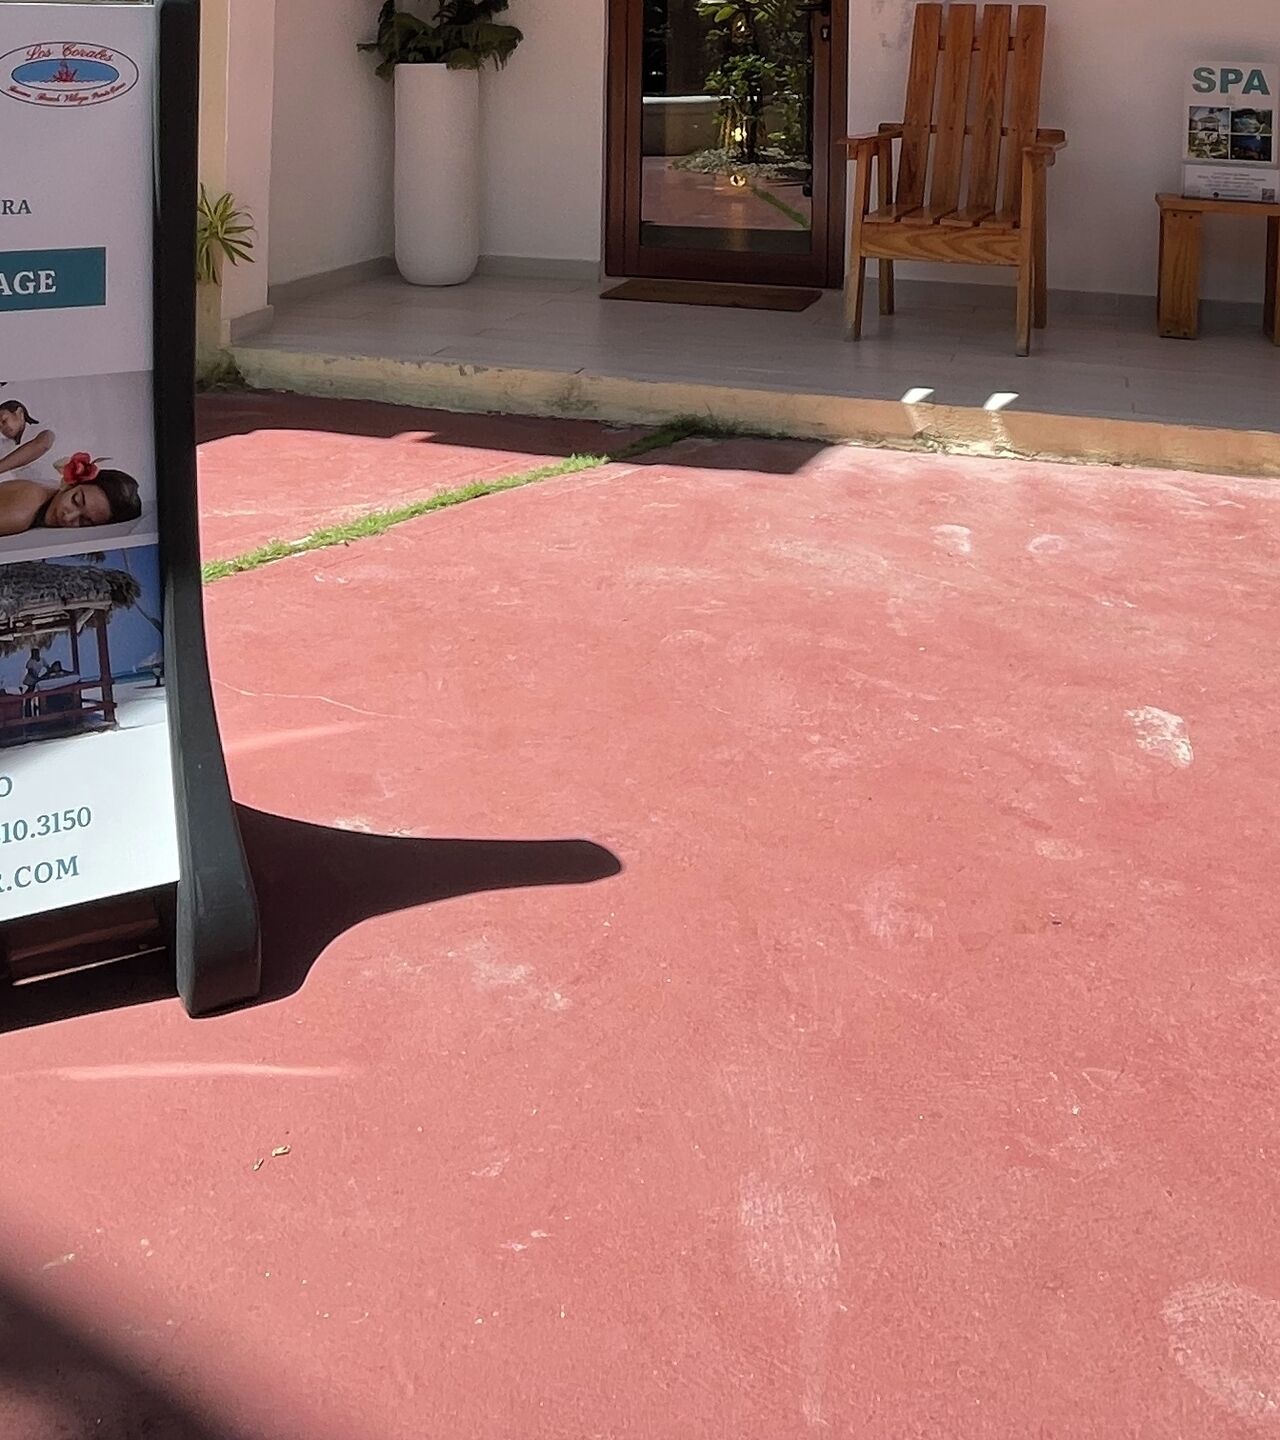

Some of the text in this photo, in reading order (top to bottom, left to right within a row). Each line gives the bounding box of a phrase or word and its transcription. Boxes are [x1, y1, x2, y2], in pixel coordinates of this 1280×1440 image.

[25, 43, 114, 62] Los Corales
[1192, 67, 1271, 96] SPA
